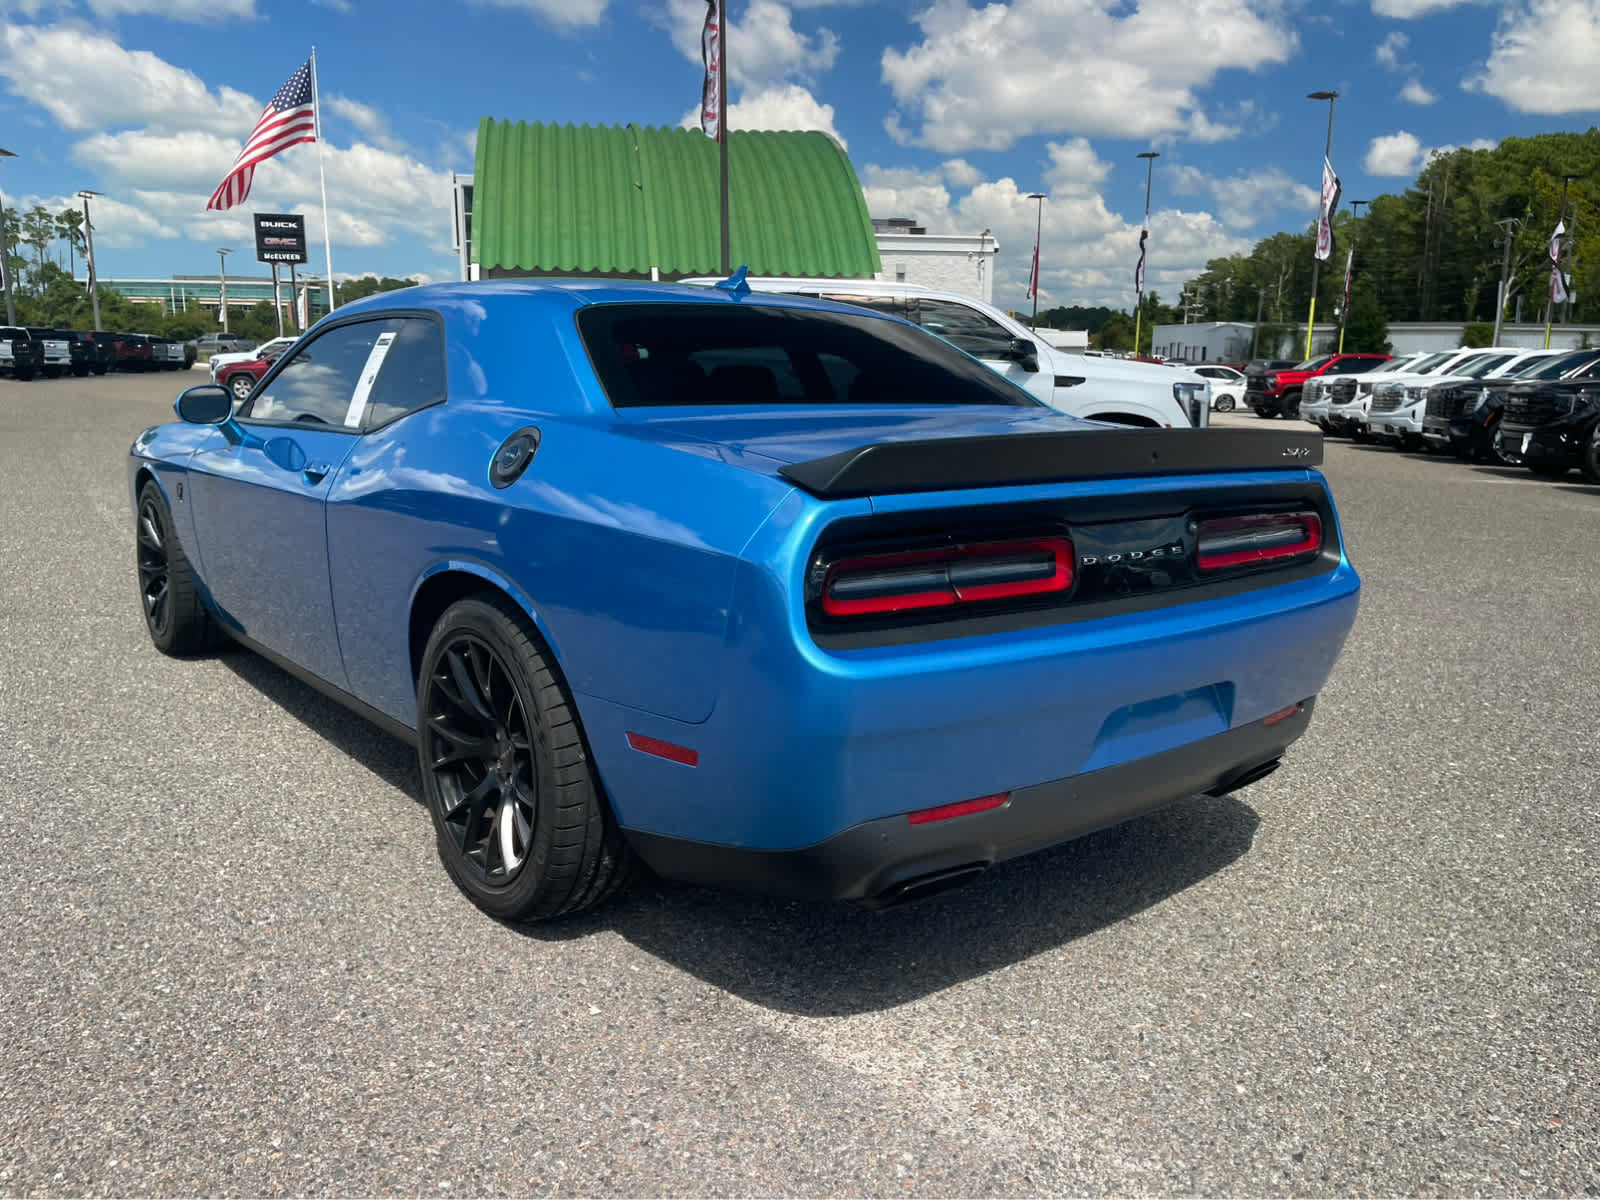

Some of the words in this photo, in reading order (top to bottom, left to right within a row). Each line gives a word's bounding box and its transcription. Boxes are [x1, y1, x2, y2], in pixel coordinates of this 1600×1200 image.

[260, 221, 298, 229] BUICK
[263, 237, 297, 246] GMC
[1082, 546, 1182, 566] DODGE
